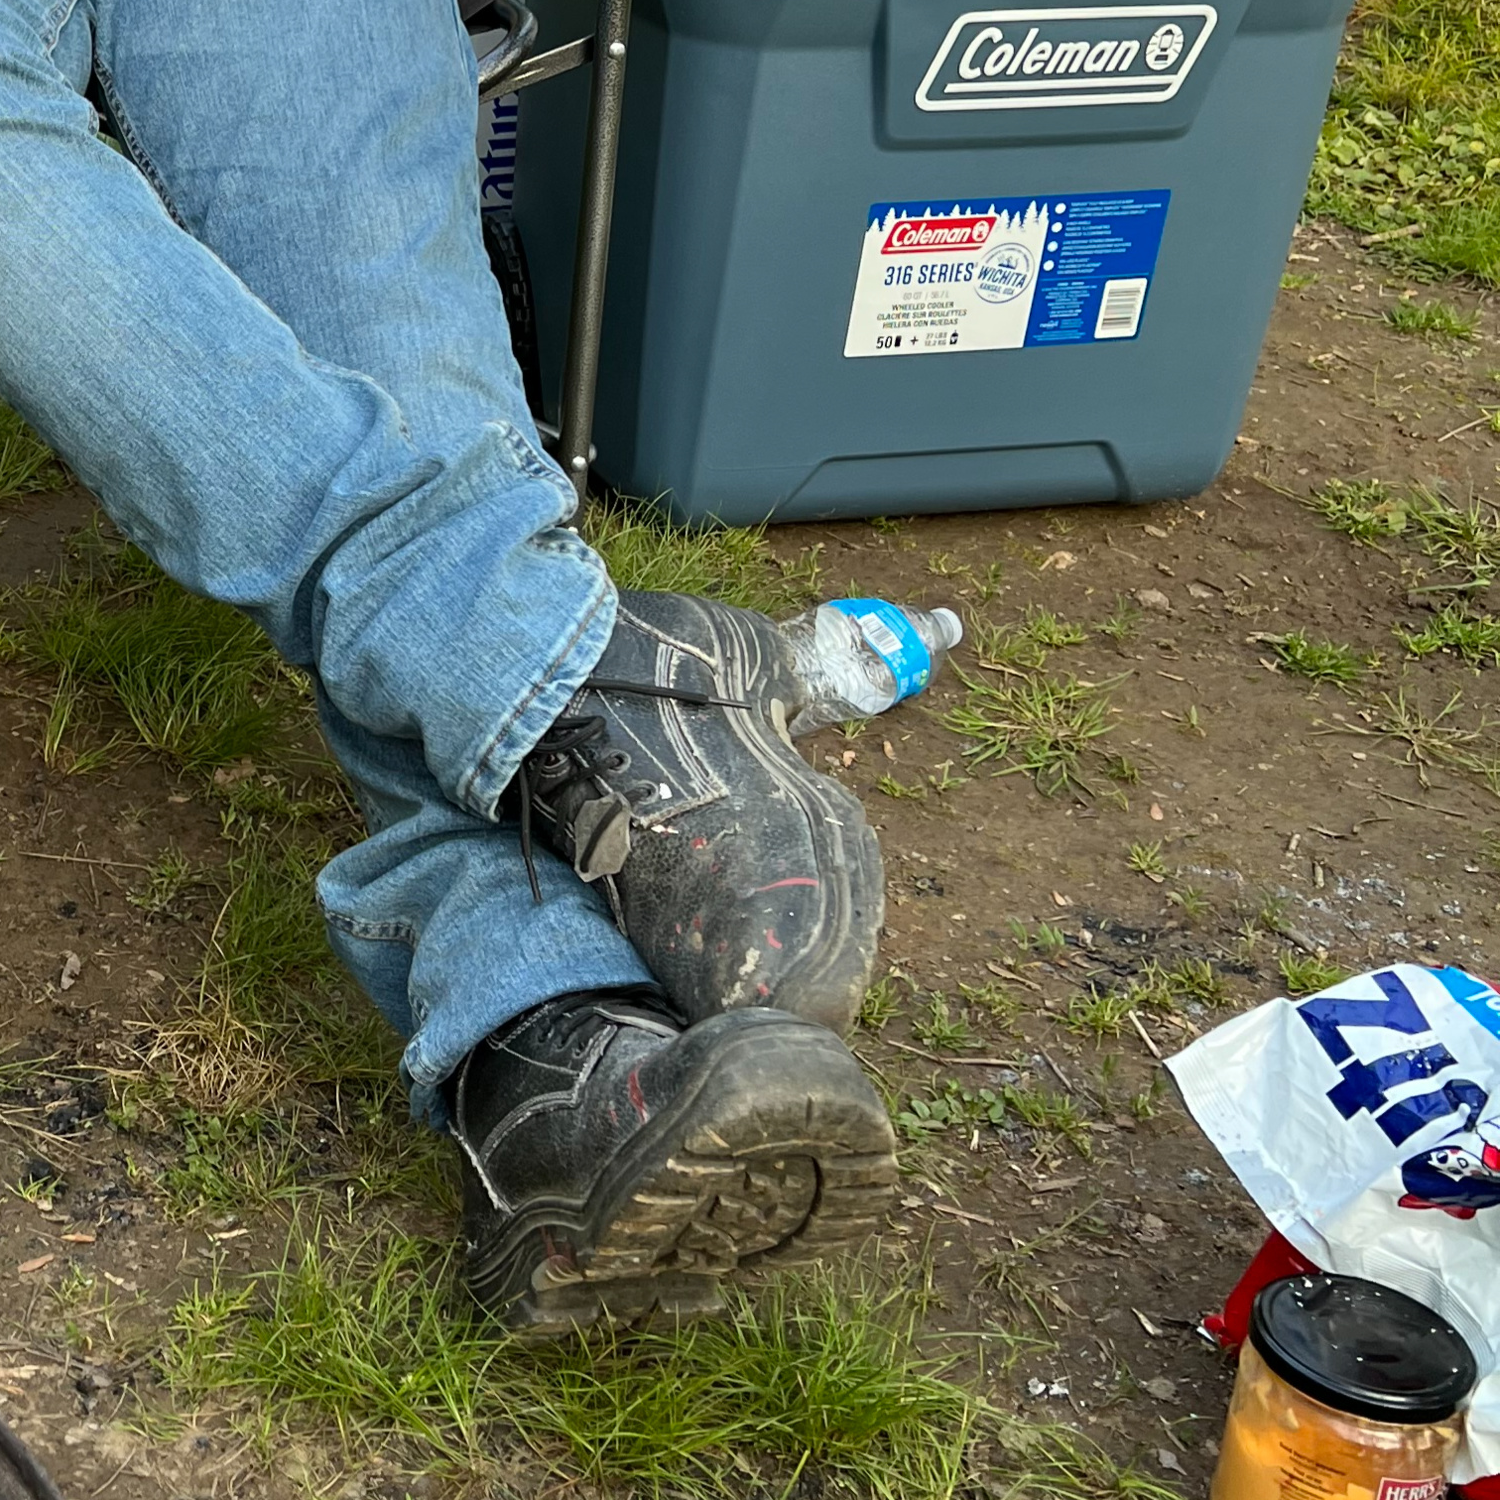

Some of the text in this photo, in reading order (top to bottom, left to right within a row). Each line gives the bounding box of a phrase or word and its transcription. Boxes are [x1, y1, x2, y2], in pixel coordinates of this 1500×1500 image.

[958, 26, 1141, 80] Coleman
[891, 222, 972, 247] Coleman
[884, 262, 975, 286] 316 SERIES
[977, 265, 1027, 289] WICHITA
[891, 301, 954, 311] WHEELED COOLER
[928, 309, 967, 318] ROULETTES
[876, 335, 893, 350] 50
